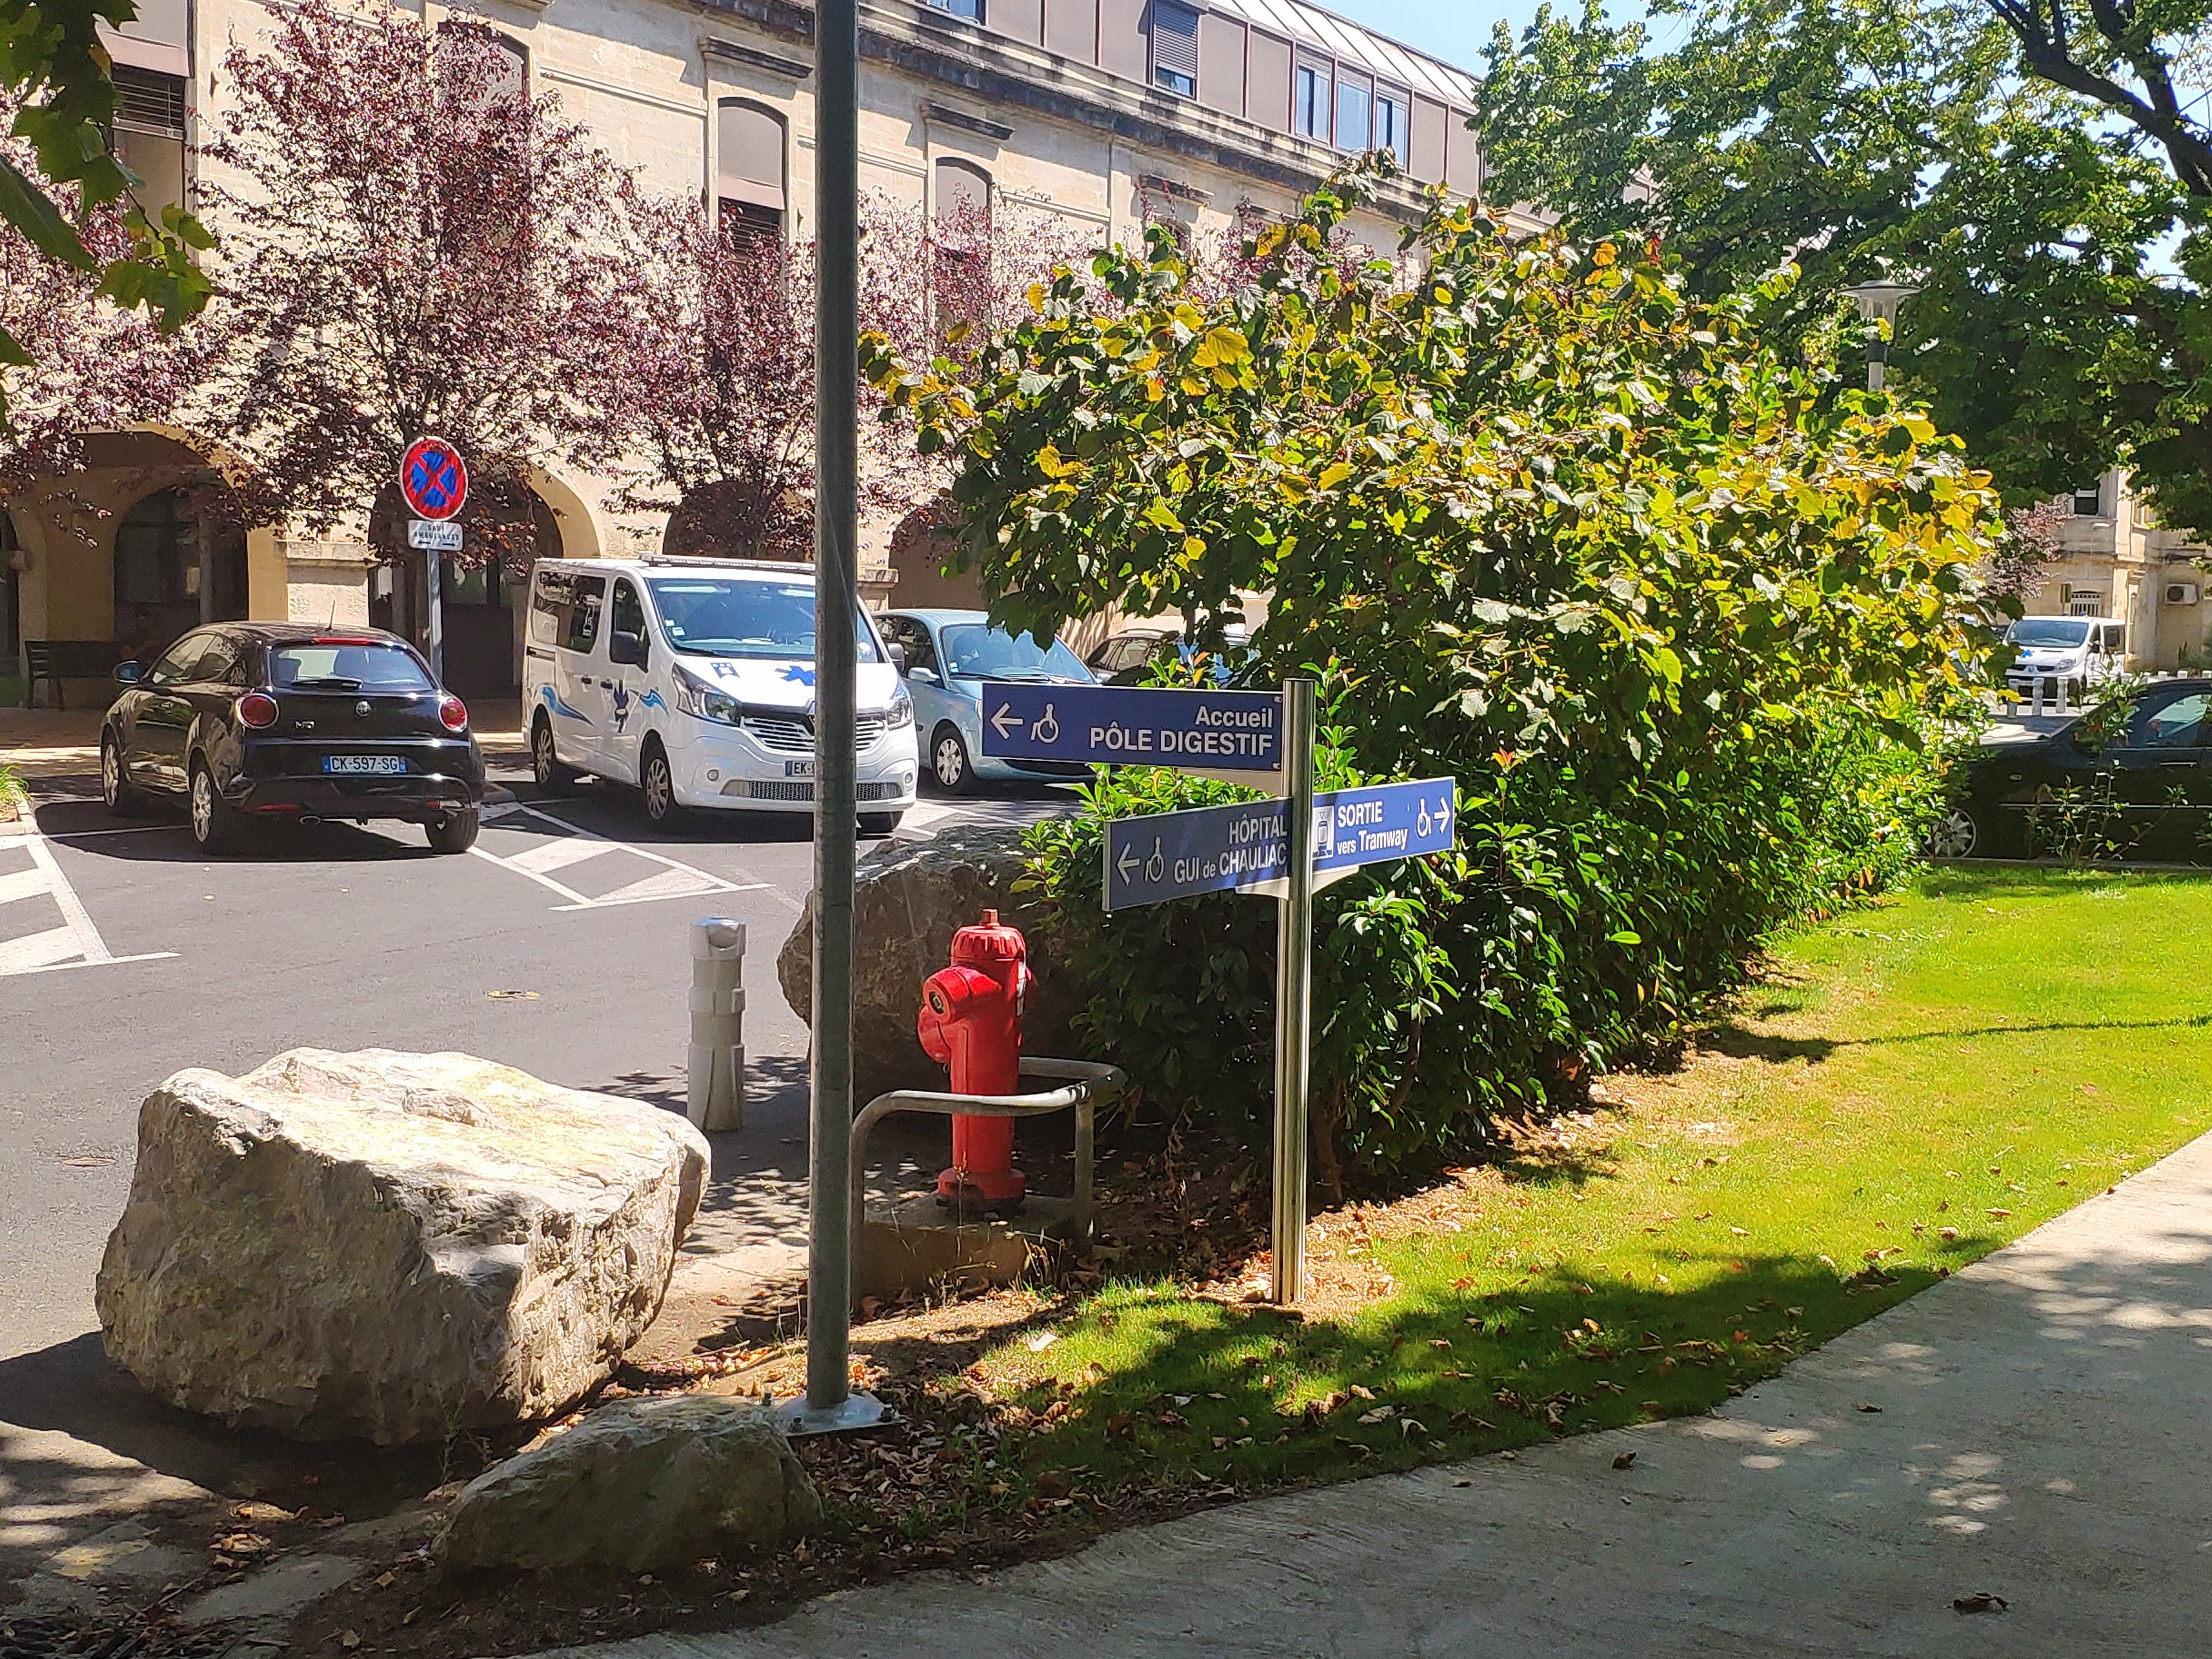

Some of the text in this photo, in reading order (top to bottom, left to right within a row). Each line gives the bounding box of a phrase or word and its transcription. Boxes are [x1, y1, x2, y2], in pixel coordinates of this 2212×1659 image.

[1194, 706, 1273, 728] Accueil
[1090, 721, 1273, 756] PÔLE DIGESTIF
[331, 757, 398, 770] CK-597-SG
[794, 762, 815, 774] EK-
[1337, 800, 1383, 828] SORTIE
[1228, 813, 1288, 844] HÔPITAL
[1336, 828, 1408, 855] vers Tramway
[1174, 842, 1287, 884] GUI de CHAULIAC
